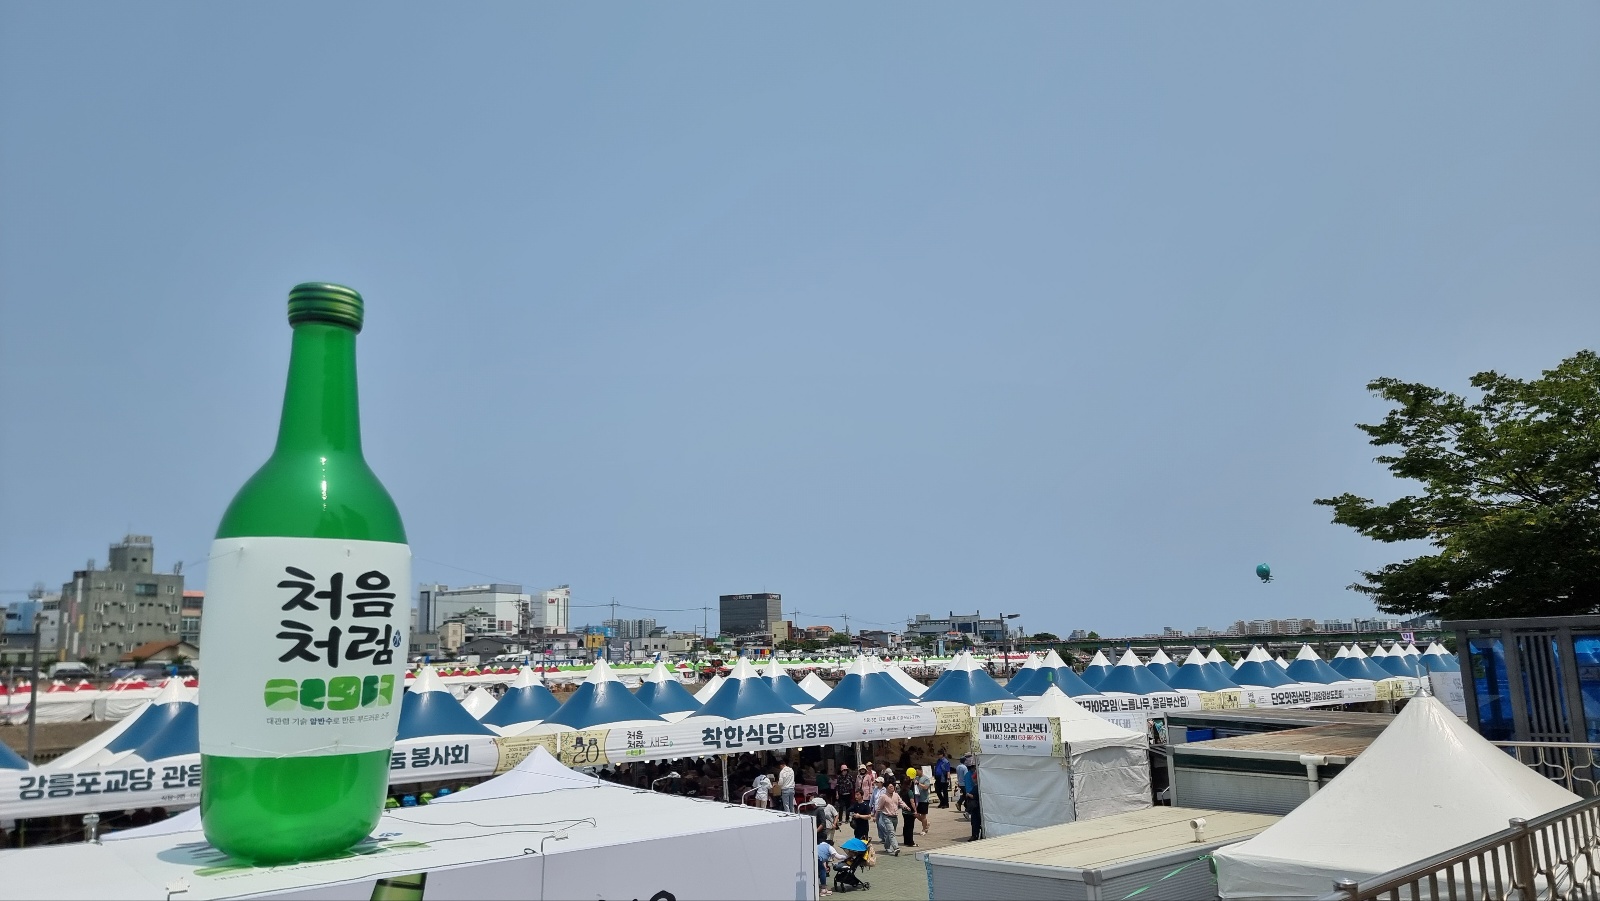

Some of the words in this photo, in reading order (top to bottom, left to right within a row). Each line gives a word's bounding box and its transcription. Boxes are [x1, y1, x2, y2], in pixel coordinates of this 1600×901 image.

[277, 566, 396, 620] 처음
[276, 620, 393, 668] 처럼
[627, 730, 644, 740] 처음
[1003, 722, 1018, 733] 요금
[19, 767, 156, 801] 강릉포교당
[411, 743, 470, 768] 봉사회
